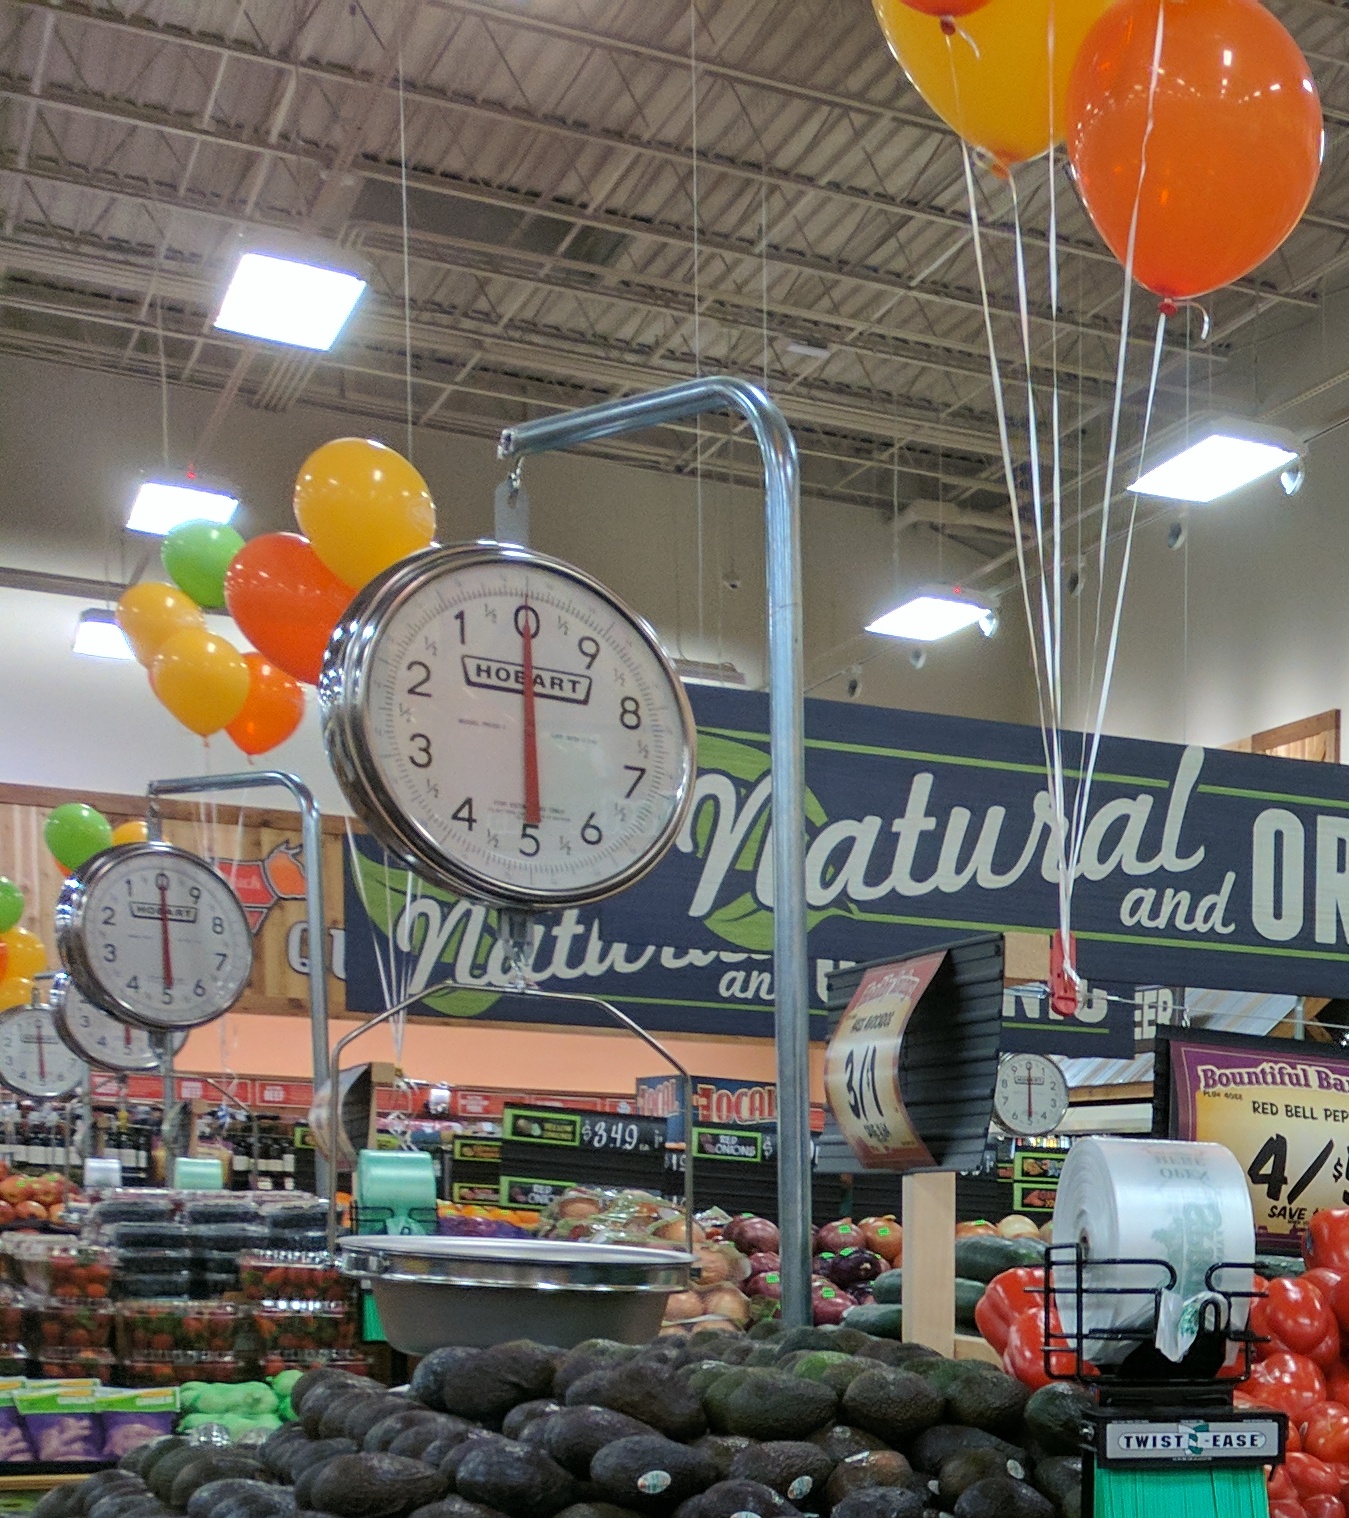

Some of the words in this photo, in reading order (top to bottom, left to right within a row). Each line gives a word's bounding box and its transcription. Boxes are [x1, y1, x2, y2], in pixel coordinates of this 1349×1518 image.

[454, 610, 466, 645] 1
[514, 604, 540, 640] 0
[578, 636, 601, 670] 9
[407, 661, 433, 698] 2
[476, 664, 581, 694] HOBART
[619, 696, 642, 730] 8
[409, 733, 433, 768] 3
[624, 765, 647, 799] 7
[451, 797, 477, 831] 4
[581, 811, 603, 845] 6
[677, 745, 1205, 917] Natural
[519, 823, 541, 857] 5
[1119, 870, 1236, 936] and
[1200, 1063, 1312, 1091] Bountiful
[1252, 1100, 1279, 1116] RED
[1285, 1104, 1318, 1120] BELL
[1267, 1204, 1307, 1221] SAVE
[1123, 1434, 1183, 1449] TWIST
